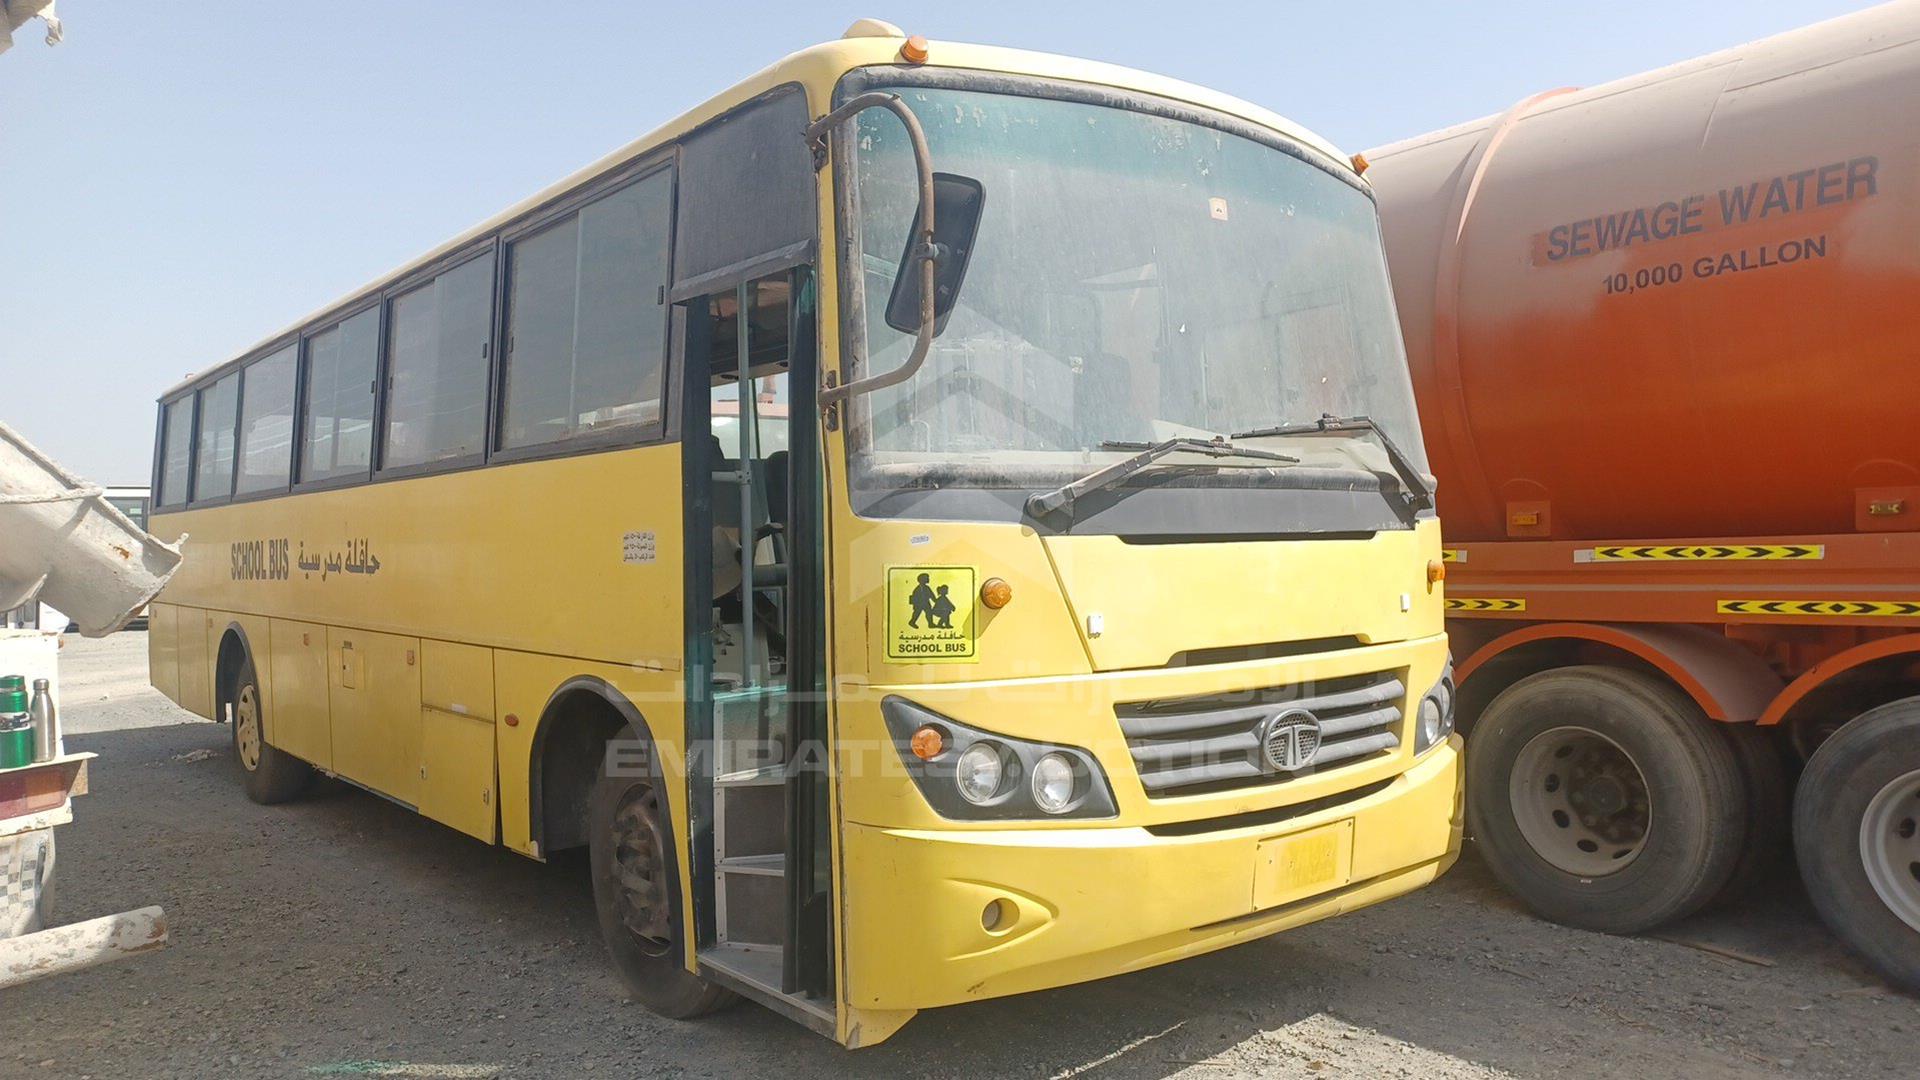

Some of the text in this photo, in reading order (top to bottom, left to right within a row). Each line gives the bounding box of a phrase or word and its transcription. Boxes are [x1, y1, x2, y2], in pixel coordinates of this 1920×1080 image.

[1547, 155, 1879, 261] SEWAGE WATER
[1602, 235, 1827, 295] 10,000 GALLON
[231, 538, 289, 581] SCHOOL BUS
[298, 537, 381, 582] حافلة مدرسية
[898, 630, 966, 643] حافلة مدرسية
[898, 643, 966, 653] SCHOOL BUS
